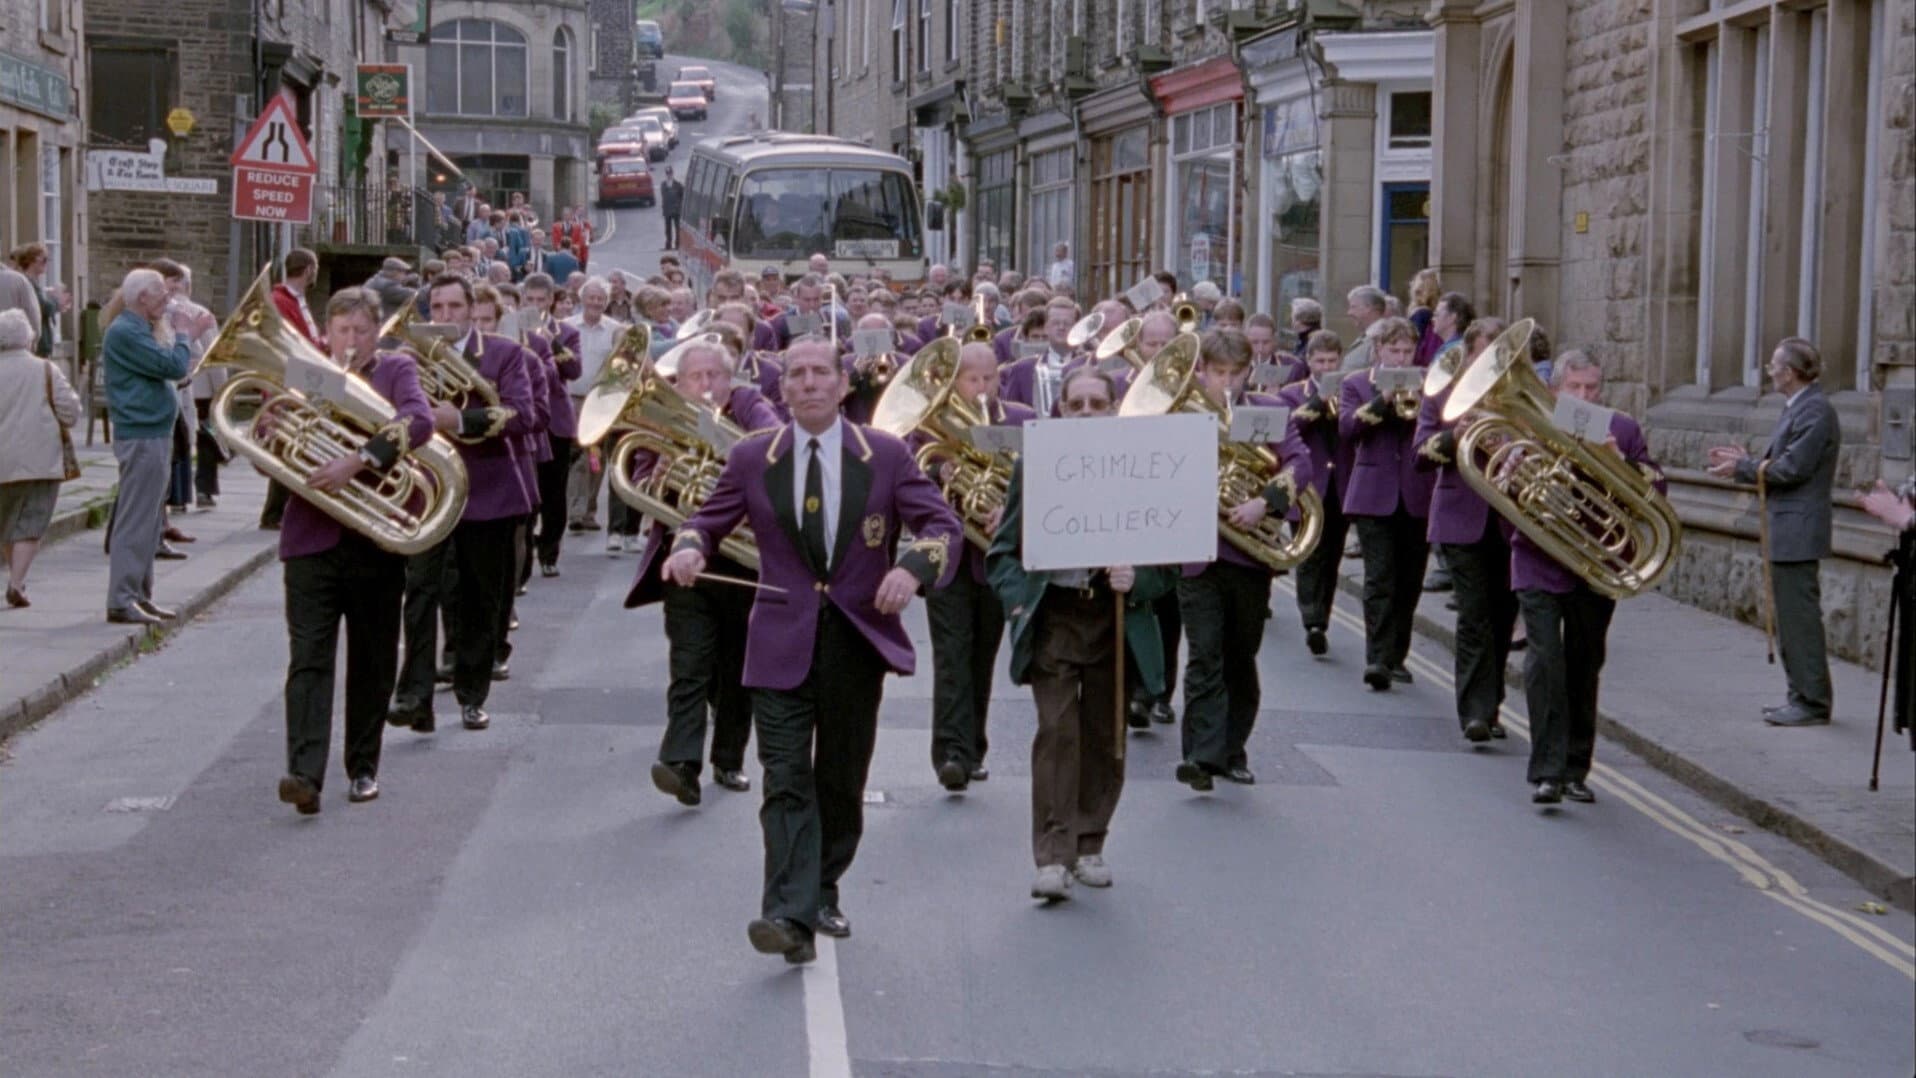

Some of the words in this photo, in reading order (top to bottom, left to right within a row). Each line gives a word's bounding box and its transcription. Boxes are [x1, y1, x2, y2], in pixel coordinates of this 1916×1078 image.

[173, 180, 214, 192] SQUARE
[247, 171, 300, 188] REDUCE
[253, 188, 295, 204] SPEED
[255, 205, 288, 218] NOW
[1055, 452, 1187, 482] GRIMLEY
[1042, 504, 1184, 536] COLLIERY
